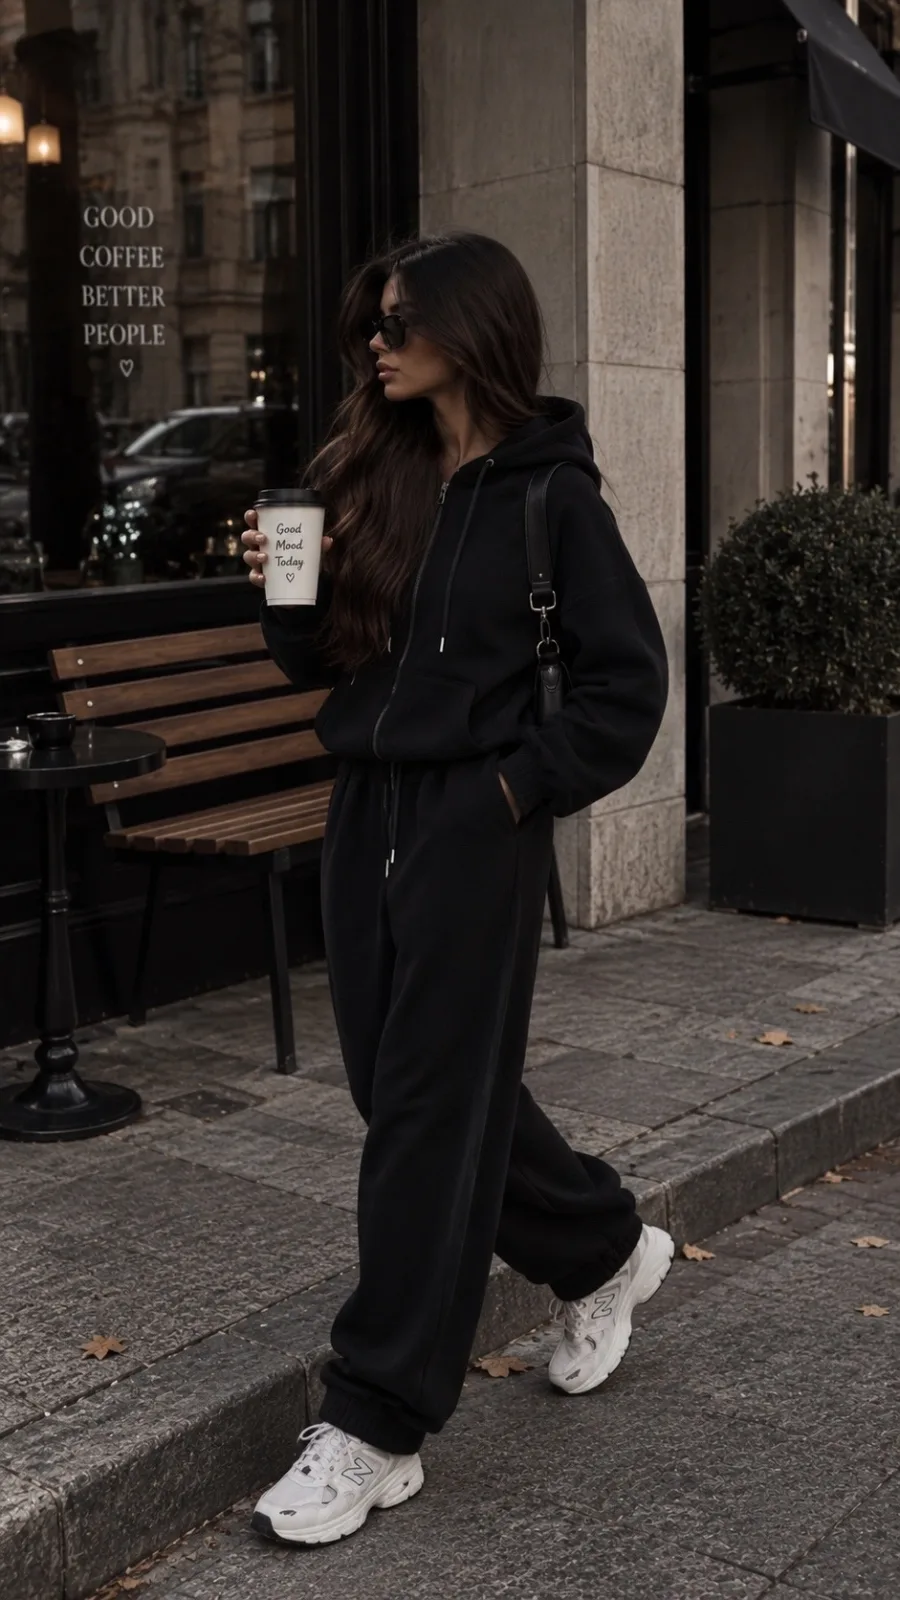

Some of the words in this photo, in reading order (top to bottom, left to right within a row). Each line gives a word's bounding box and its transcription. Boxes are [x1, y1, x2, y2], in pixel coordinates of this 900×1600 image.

[83, 206, 154, 228] GOOD
[79, 245, 165, 268] COFFEE
[81, 285, 166, 307] BETTER
[83, 323, 165, 346] PEOPLE
[276, 523, 302, 535] Good
[275, 540, 304, 551] Mood
[274, 556, 304, 570] Today
[341, 1457, 373, 1486] N
